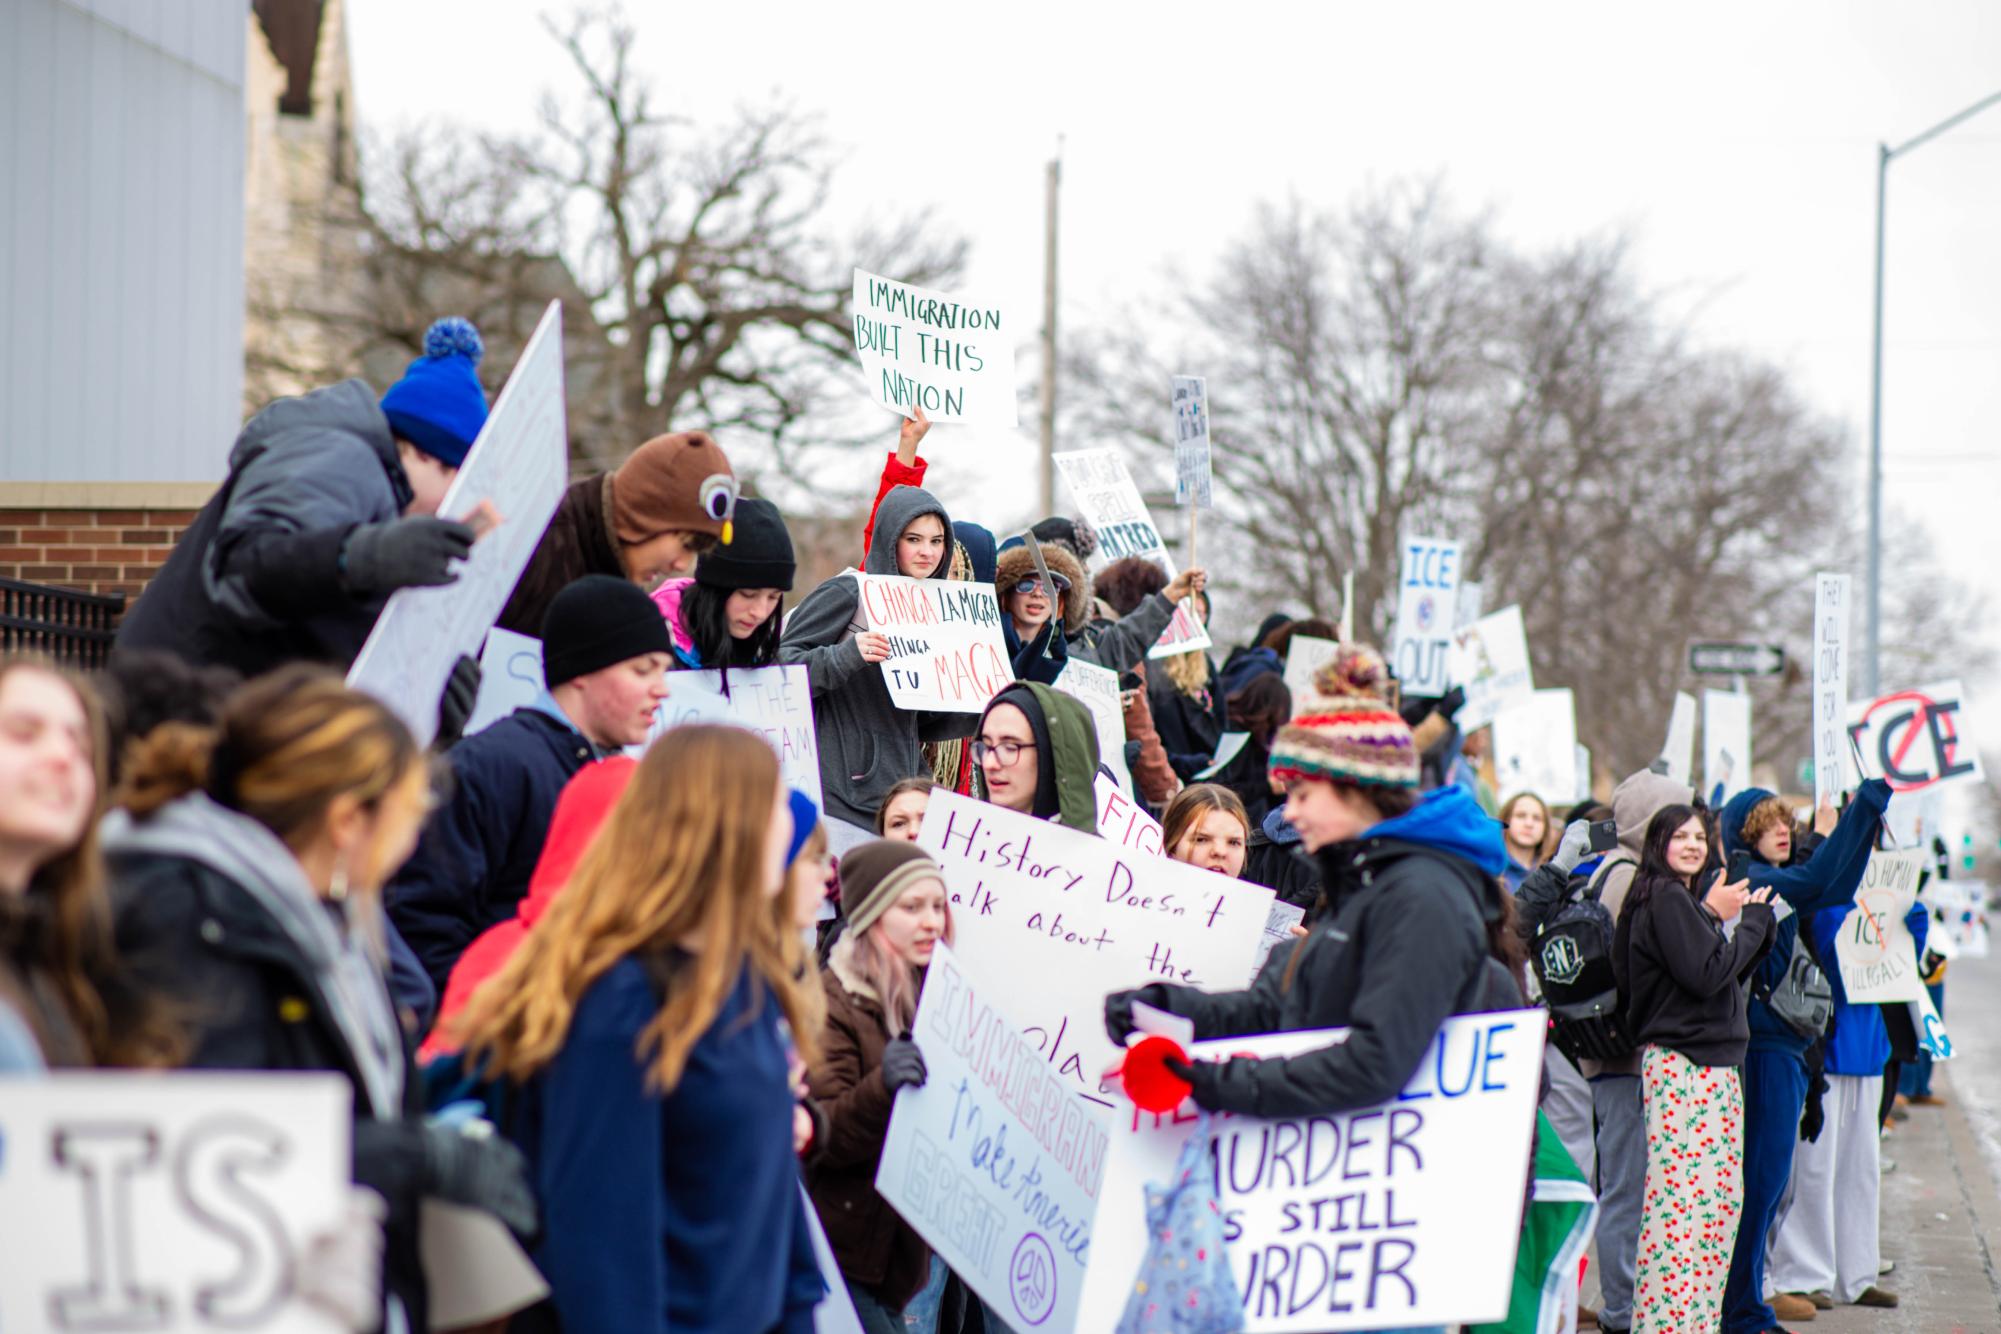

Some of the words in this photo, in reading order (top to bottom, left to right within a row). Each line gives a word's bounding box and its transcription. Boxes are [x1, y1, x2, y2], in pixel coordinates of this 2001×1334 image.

[869, 278, 1000, 330] IMMIGRATION
[856, 314, 902, 360] BUILT
[916, 332, 983, 372] THIS
[882, 367, 963, 416] NATION
[1406, 545, 1455, 589] ICE
[863, 579, 939, 627] CHINGA
[937, 587, 960, 622] LA
[958, 588, 1000, 628] MIGRA
[885, 635, 932, 661] HINGA
[891, 669, 920, 690] TU
[934, 641, 1010, 702] MAGA
[1397, 638, 1450, 687] OUT
[750, 682, 798, 718] THE
[1101, 792, 1163, 856] FIG
[941, 810, 1083, 891] History
[1105, 860, 1225, 929] Doesn't
[1859, 858, 1877, 890] O
[948, 880, 999, 916] alk
[1026, 911, 1115, 952] about
[1145, 941, 1203, 985] the
[1855, 911, 1886, 945] ICE
[930, 961, 1109, 1198] IMMIGRAN
[47, 1111, 299, 1331] IS
[1222, 1209, 1246, 1242] S
[1280, 1189, 1418, 1234] STILL
[1242, 1238, 1419, 1319] RDER
